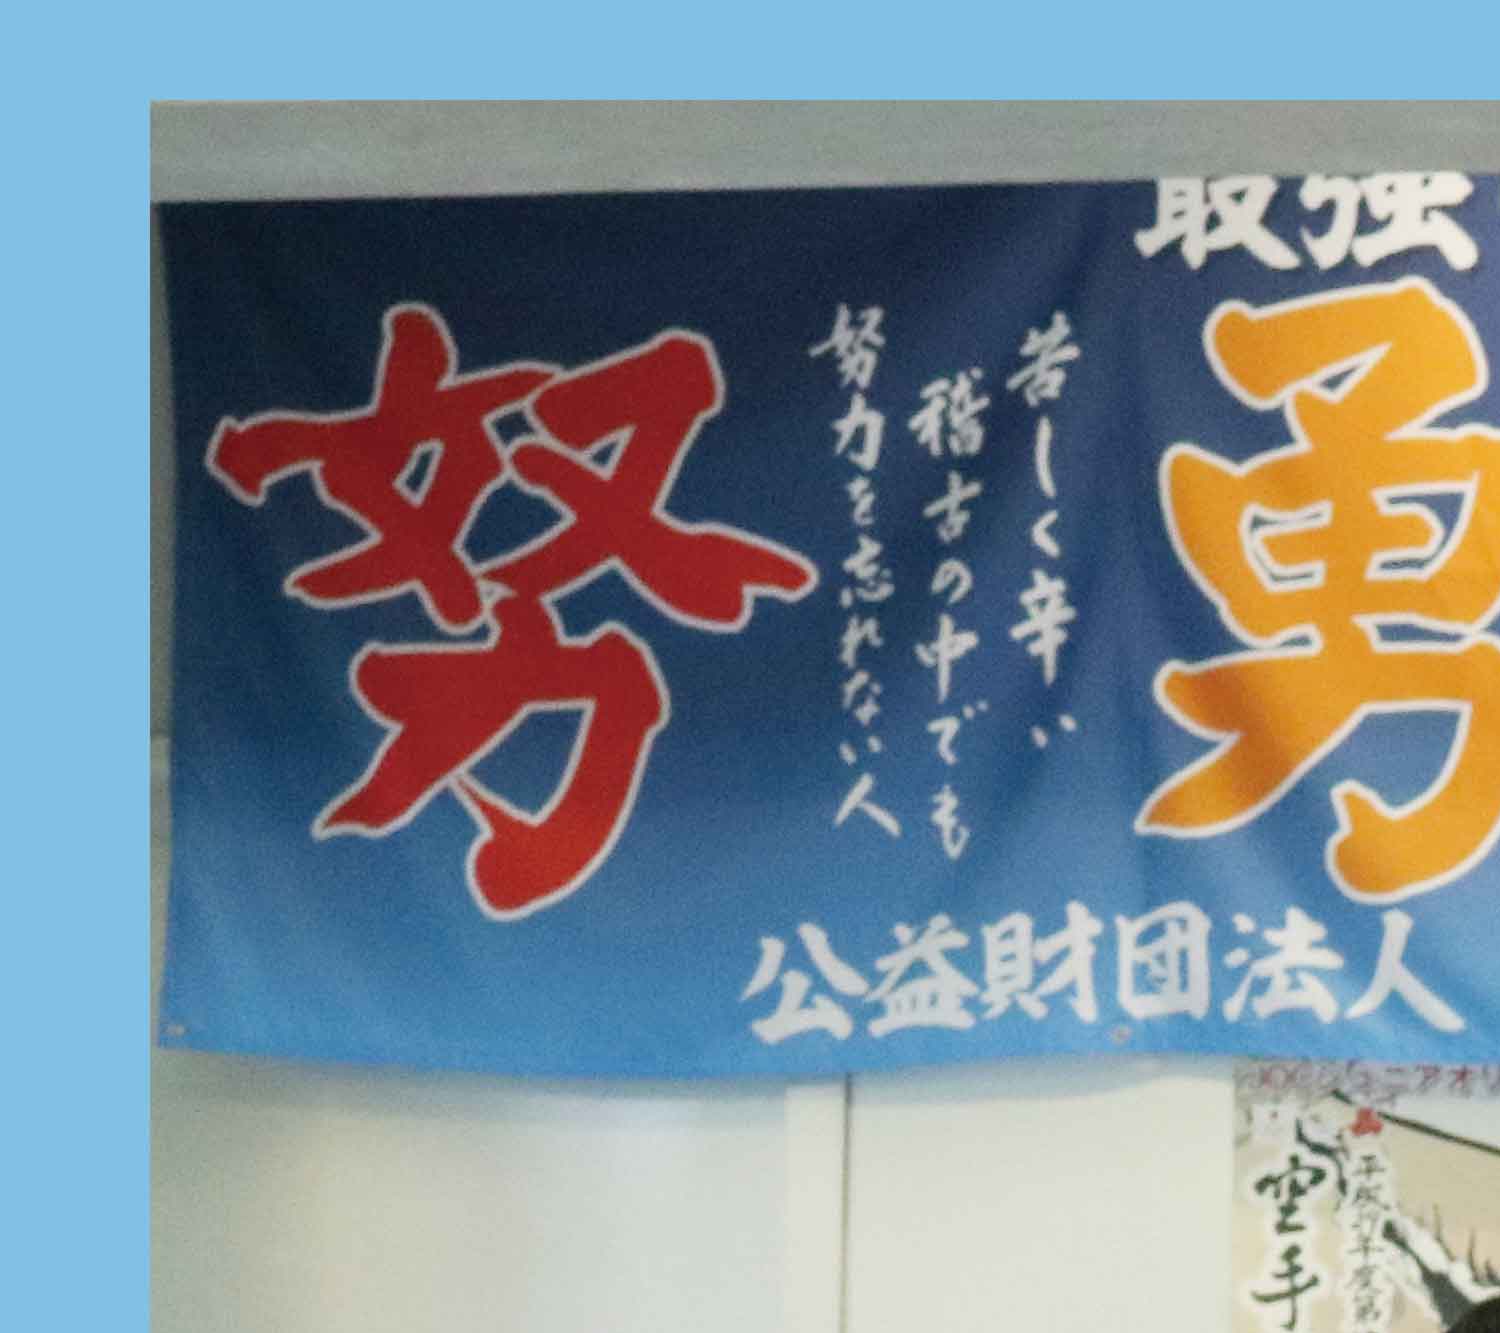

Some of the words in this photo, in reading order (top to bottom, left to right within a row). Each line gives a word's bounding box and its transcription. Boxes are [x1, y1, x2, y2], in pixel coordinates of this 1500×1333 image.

[206, 303, 819, 921] 努
[809, 302, 902, 838] 努力を忘れない人
[906, 368, 991, 860] 稽古の中でも
[1006, 312, 1082, 750] 苦しく辛い
[740, 901, 1466, 1044] 公益財団法人
